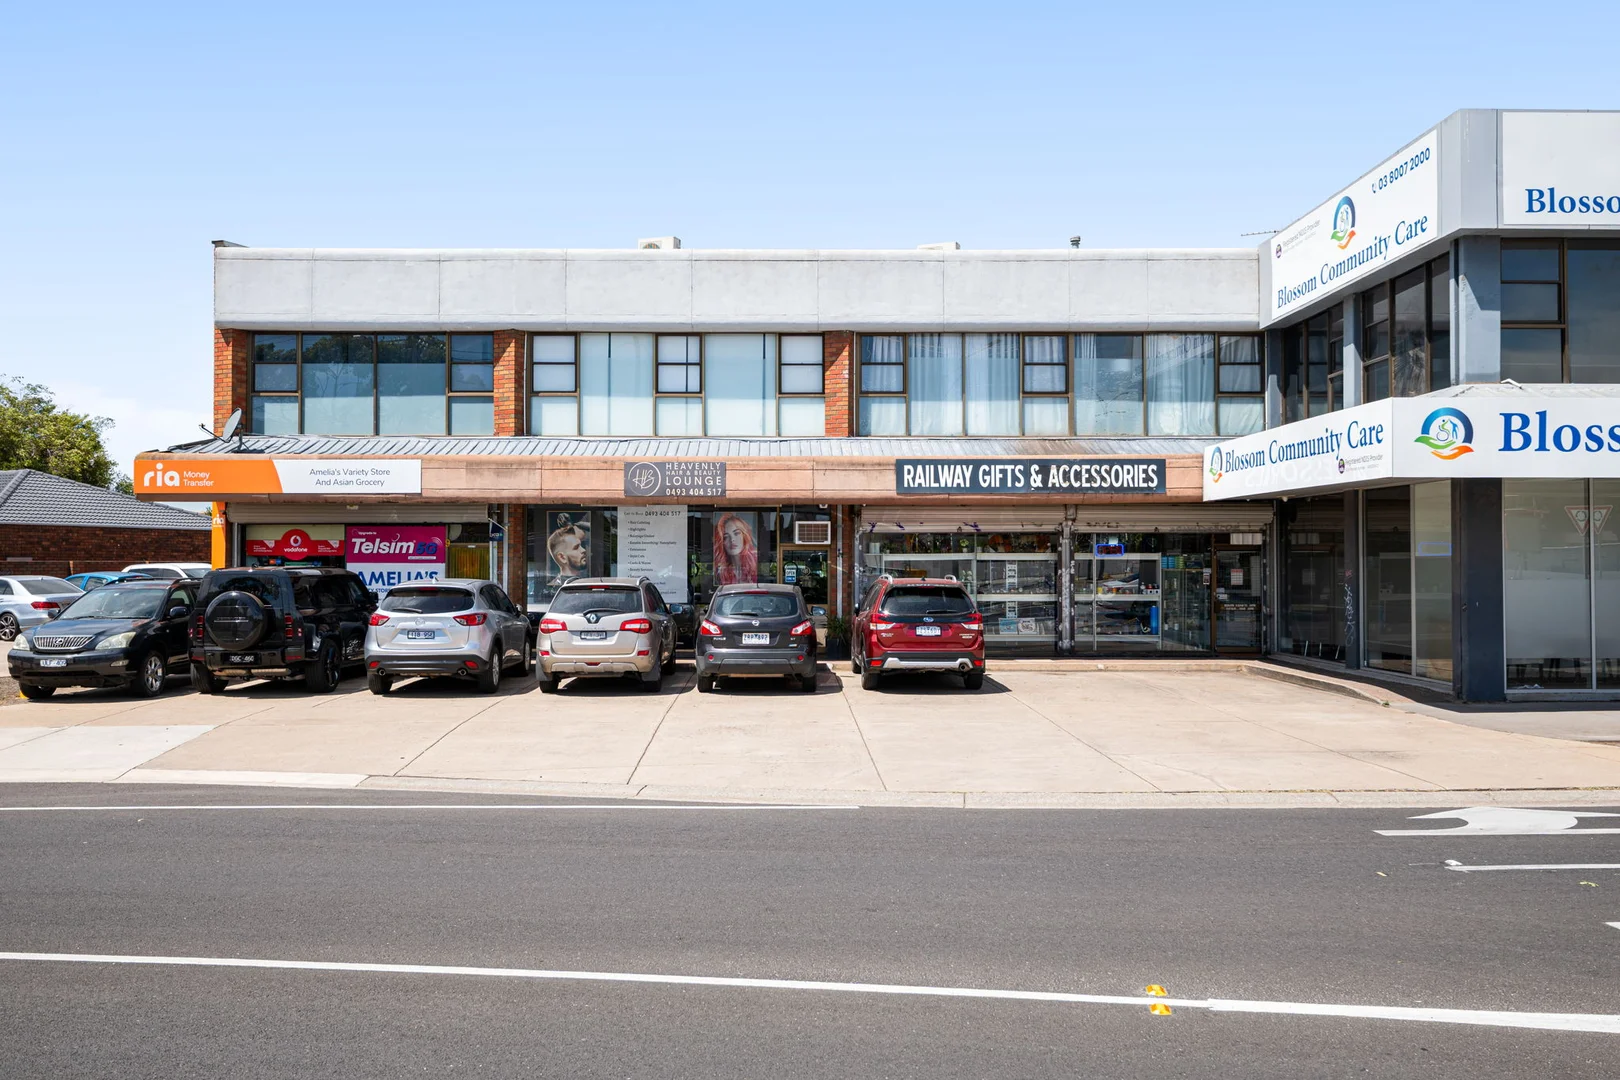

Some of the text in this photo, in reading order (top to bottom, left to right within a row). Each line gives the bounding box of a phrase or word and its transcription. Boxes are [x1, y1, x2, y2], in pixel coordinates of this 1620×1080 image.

[1378, 147, 1431, 191] 03 8007 2000
[1277, 273, 1318, 309] Blossom
[1320, 233, 1391, 286] Community
[1395, 213, 1428, 245] Care
[1225, 449, 1265, 473] Blossom
[1269, 427, 1343, 464] Community
[1347, 420, 1384, 449] Care
[665, 462, 722, 470] HEAVENLY
[143, 462, 181, 487] ria
[183, 470, 211, 480] Money
[309, 467, 391, 479] Amelia's Variety Store
[903, 464, 1159, 489] RAILWAY GIFTS & ACCESSORIES
[183, 479, 215, 487] Transfer
[315, 477, 385, 488] And Asian Grocery
[665, 476, 723, 486] LOUNGE
[665, 488, 722, 496] 0493 404 517
[351, 535, 415, 554] Telsim
[416, 542, 437, 555] 5G
